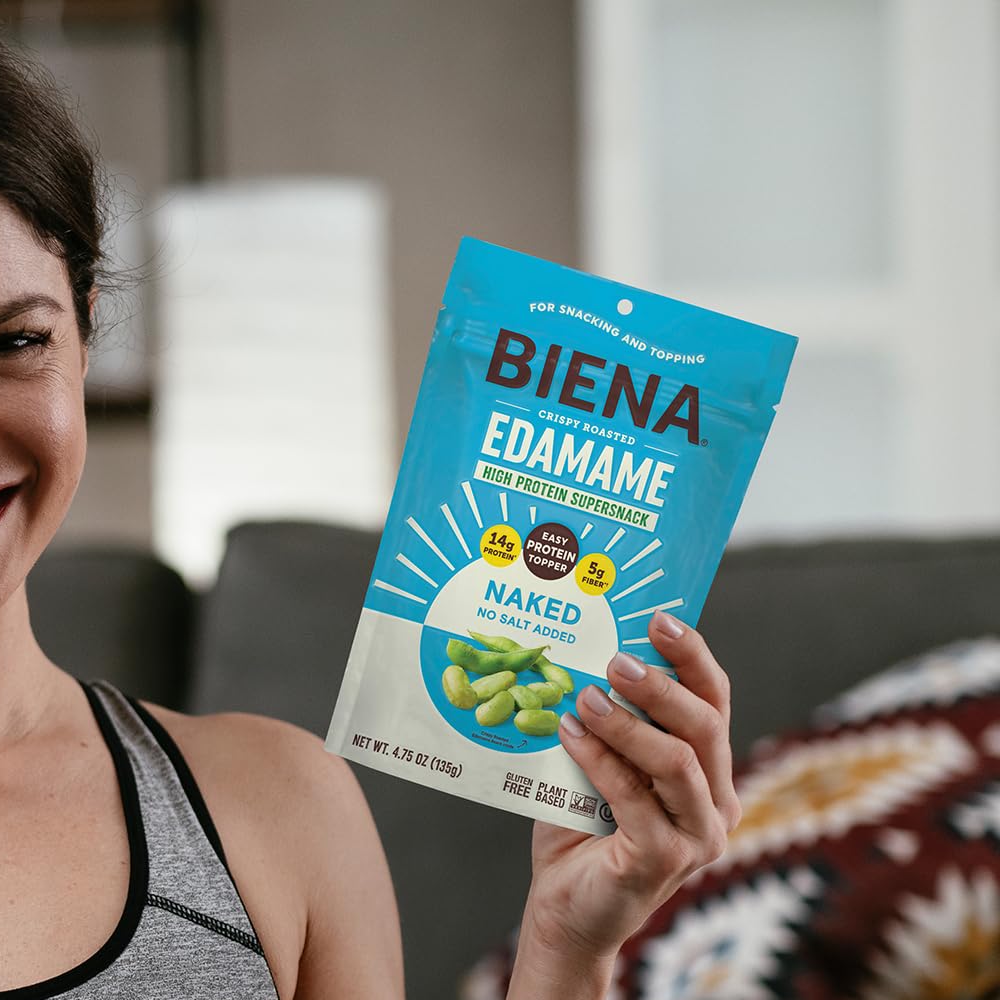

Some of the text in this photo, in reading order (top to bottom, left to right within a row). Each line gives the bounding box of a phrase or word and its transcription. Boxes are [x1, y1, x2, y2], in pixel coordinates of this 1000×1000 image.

[529, 303, 705, 365] FOR SNACKING AND TOPPING
[485, 328, 700, 446] BIENA
[538, 410, 636, 445] CRISPY ROASTED
[480, 411, 676, 508] EDAMAME
[482, 466, 650, 527] HIGH PROTEIN SUPERSNACK
[488, 532, 515, 552] 14g
[541, 531, 569, 546] EASY
[526, 540, 577, 563] PROTEIN
[528, 554, 568, 573] TOPPER
[588, 561, 605, 579] 5g
[484, 580, 581, 625] NAKED
[477, 607, 577, 644] NO SALT ADDED
[352, 734, 463, 778] NET WT. 4.75 OZ (135g)
[503, 780, 532, 799] FREE
[506, 772, 534, 787] GLUTEN
[538, 781, 568, 799] PLANT
[535, 791, 566, 809] BASED
